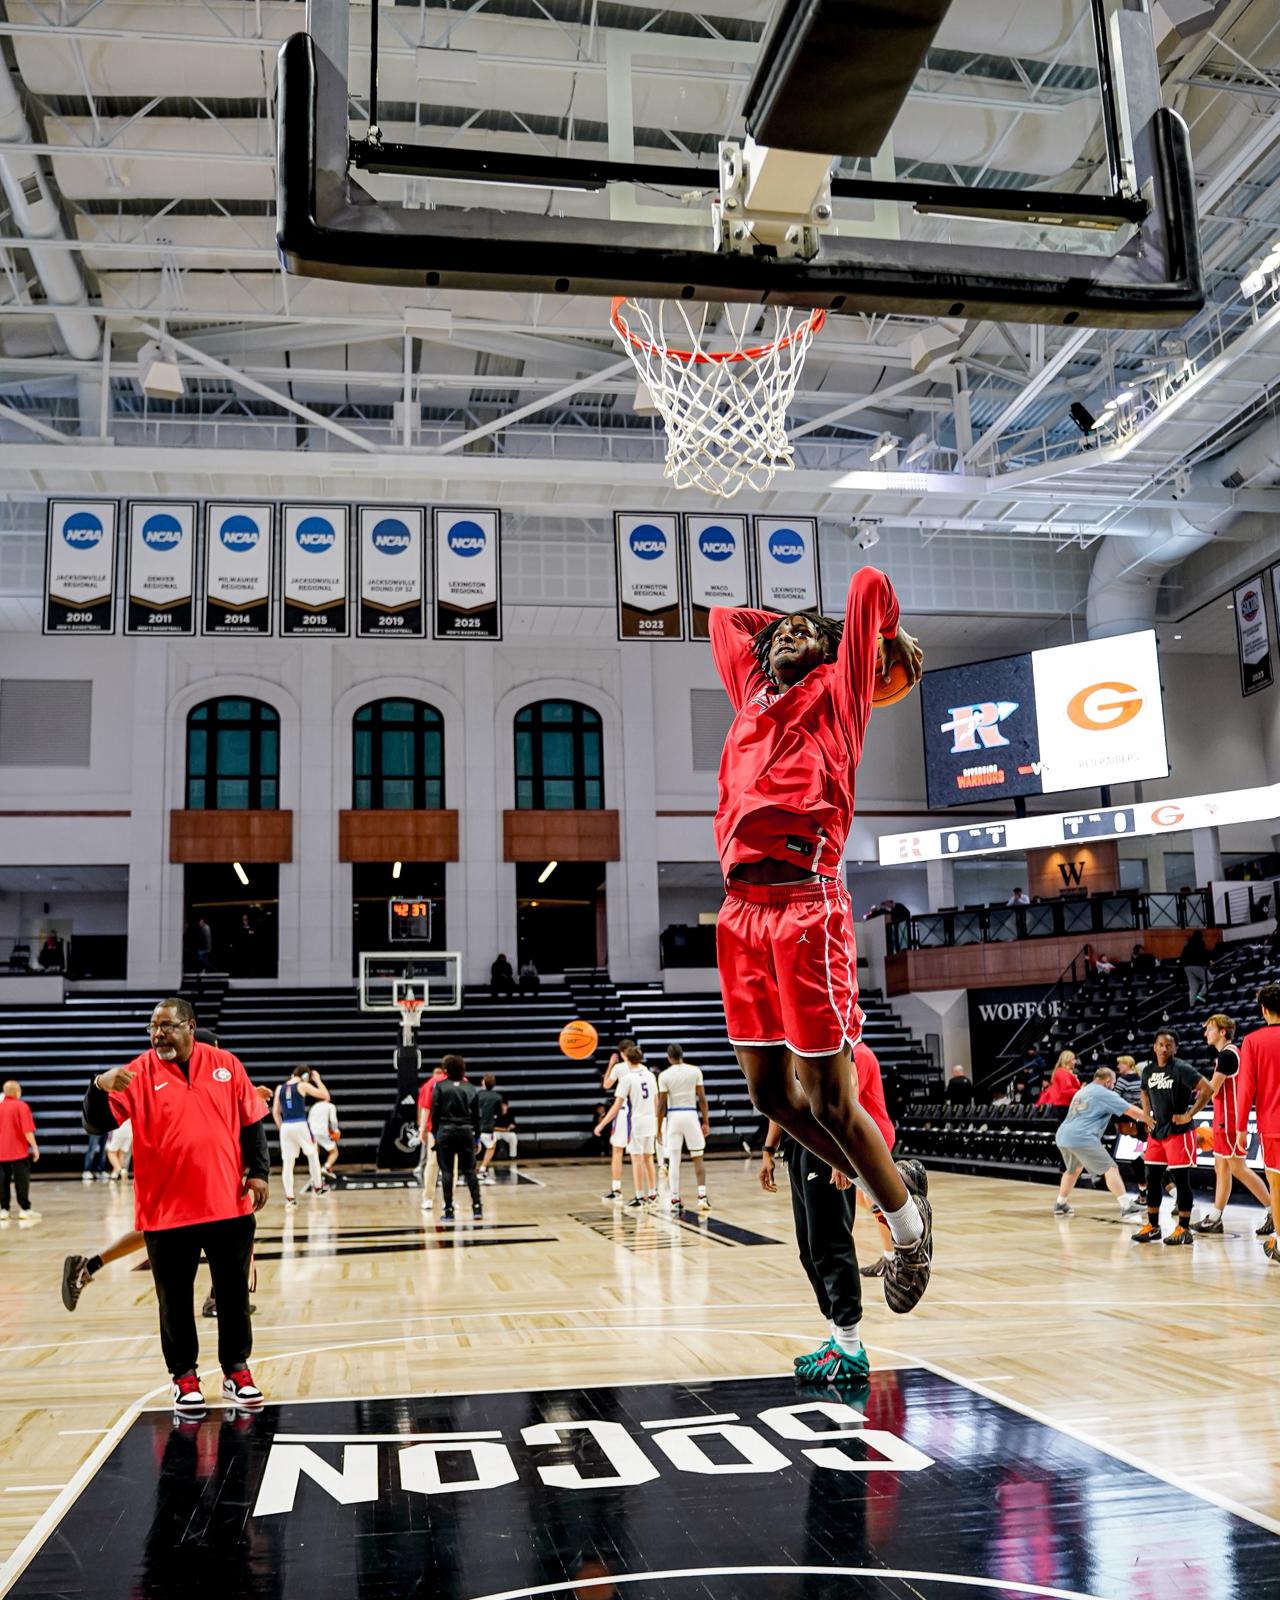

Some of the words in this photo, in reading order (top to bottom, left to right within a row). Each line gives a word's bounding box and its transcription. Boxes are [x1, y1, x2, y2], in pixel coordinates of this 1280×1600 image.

[66, 529, 102, 541] NCAA
[146, 531, 182, 543] NCAA
[224, 532, 259, 544] NCAA
[300, 533, 335, 545] NCAA
[375, 535, 411, 547] NCAA
[451, 538, 486, 550] NCAA
[633, 540, 667, 552] NCAA
[702, 542, 735, 554] NCAA
[772, 544, 804, 556] NCAA
[66, 612, 93, 623] 2010
[149, 613, 172, 624] 2011
[225, 614, 250, 624] 2014
[303, 615, 328, 625] 2015
[379, 616, 404, 626] 2019
[454, 618, 481, 628] 2025
[639, 620, 664, 629] 2023
[1066, 681, 1143, 731] G
[948, 702, 1010, 754] R
[1151, 805, 1185, 826] G
[1058, 861, 1086, 886] W
[1151, 1072, 1165, 1082] JUST
[641, 1082, 649, 1099] 5
